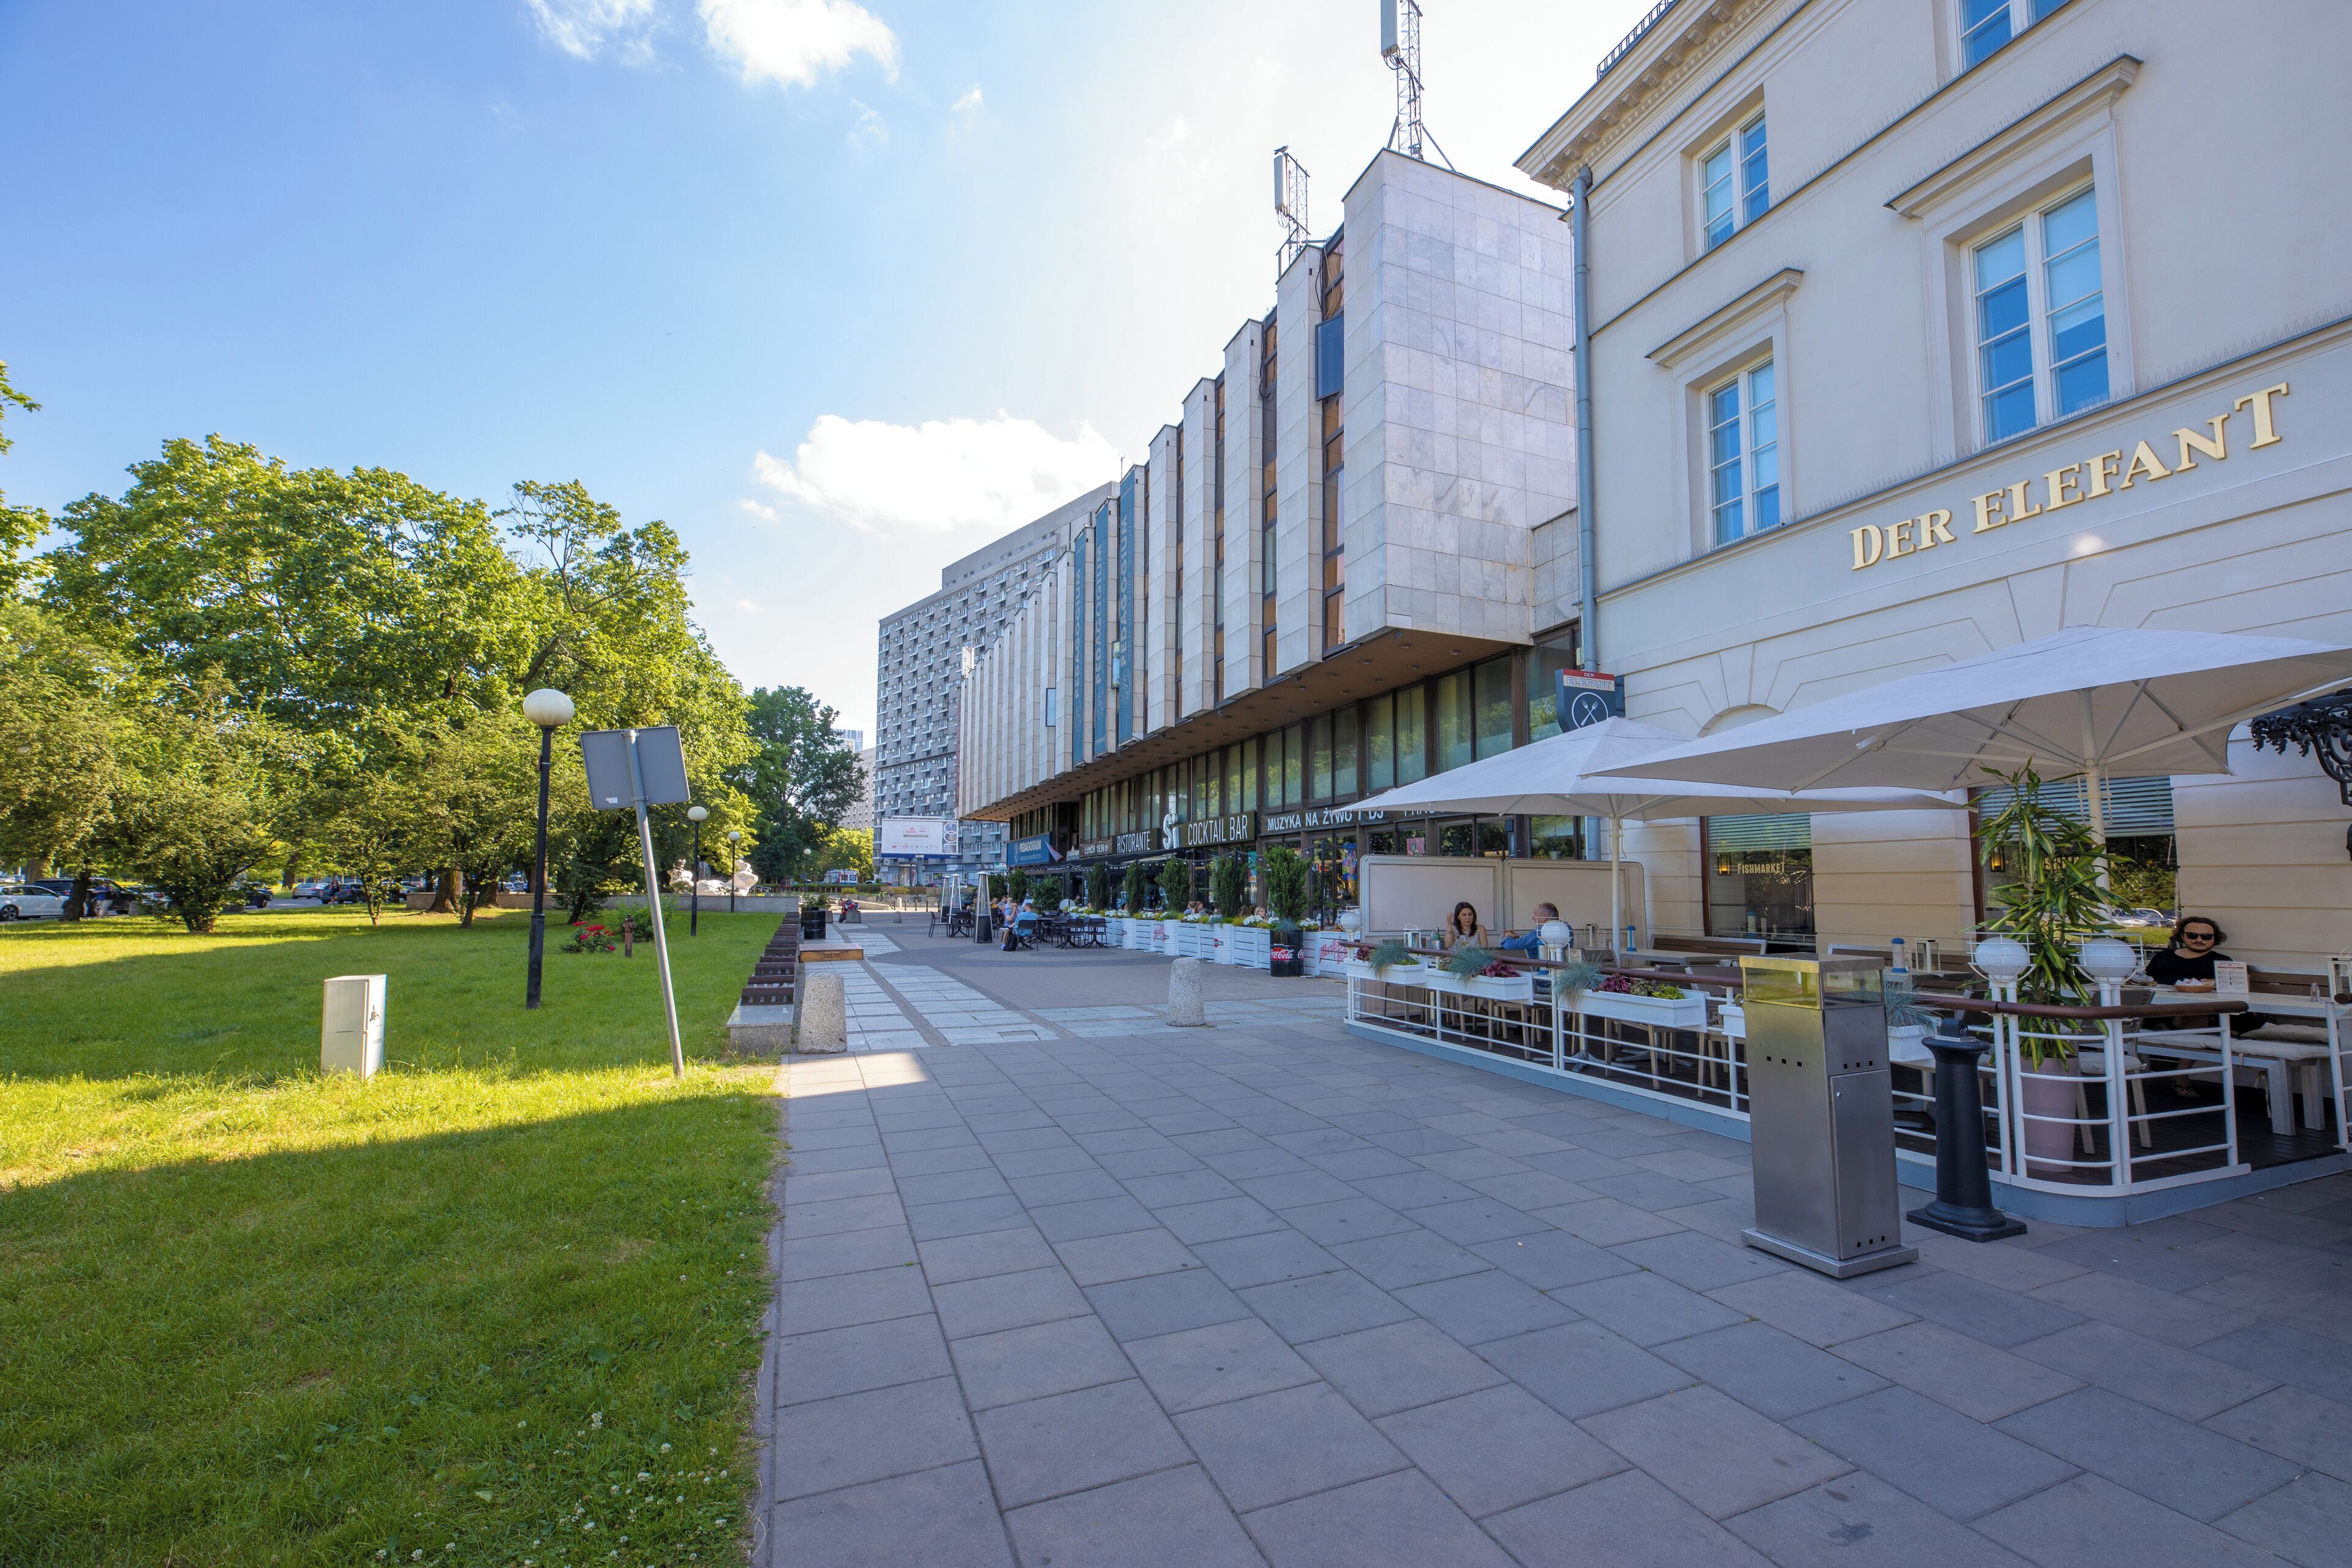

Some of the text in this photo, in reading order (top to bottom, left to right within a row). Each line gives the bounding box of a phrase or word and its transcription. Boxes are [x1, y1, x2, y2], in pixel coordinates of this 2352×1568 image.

[1849, 382, 2290, 571] DER ELEFANT
[1567, 677, 1611, 689] ELEFANT
[1267, 813, 1301, 831] MUZYKA
[1305, 812, 1318, 826] NA
[1117, 831, 1151, 854] RISTORANTE
[1188, 819, 1226, 845] COCKTAIL
[1229, 815, 1248, 841] BAR
[1019, 839, 1042, 853] PEDAGOGIUM
[1738, 861, 1785, 874] FISHMARKET
